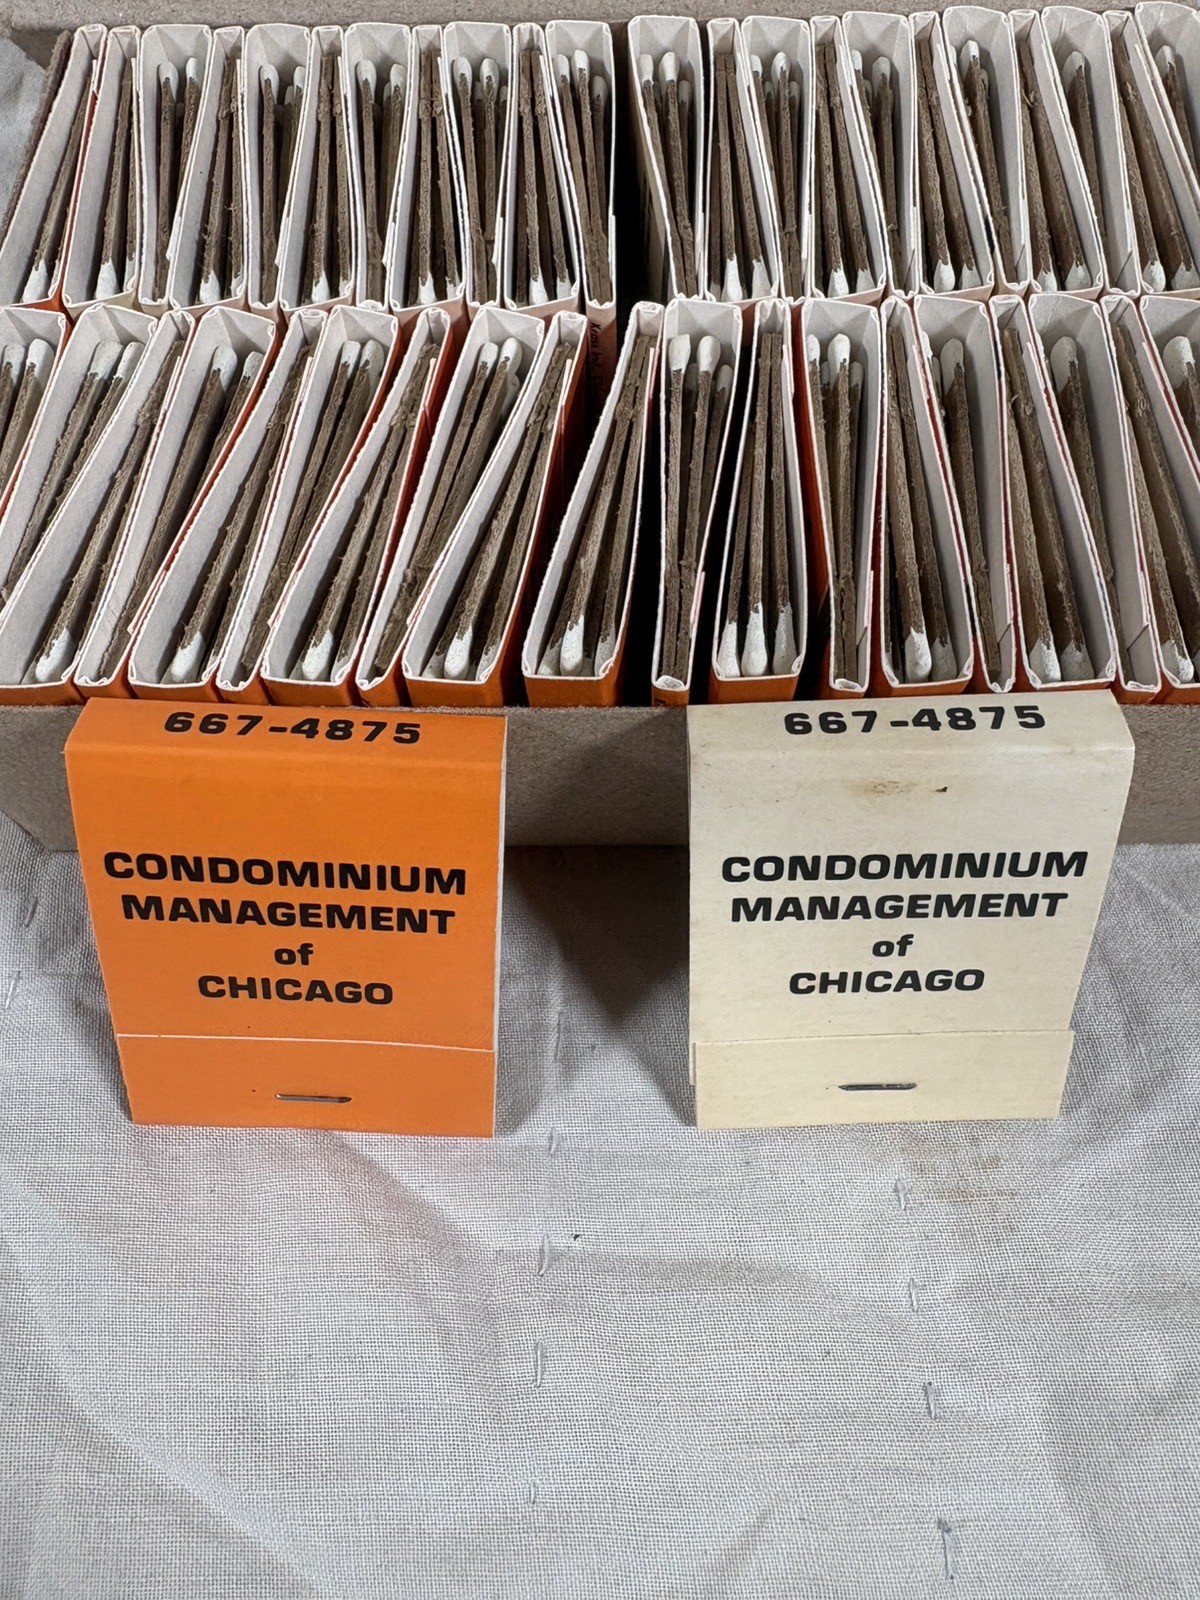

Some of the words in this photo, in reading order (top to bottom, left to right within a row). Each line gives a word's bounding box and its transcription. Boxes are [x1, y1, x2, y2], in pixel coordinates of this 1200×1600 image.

[164, 711, 421, 744] 667-4875
[783, 705, 1046, 735] 667-4875
[103, 851, 467, 896] CONDOMINIUM
[721, 851, 1088, 882] CONDOMINIUM
[121, 894, 456, 934] MANAGEMENT
[731, 893, 1068, 922] MANAGEMENT
[274, 943, 314, 966] of
[872, 934, 914, 958] of
[197, 975, 393, 1005] CHICAGO
[789, 969, 985, 994] CHICAGO
